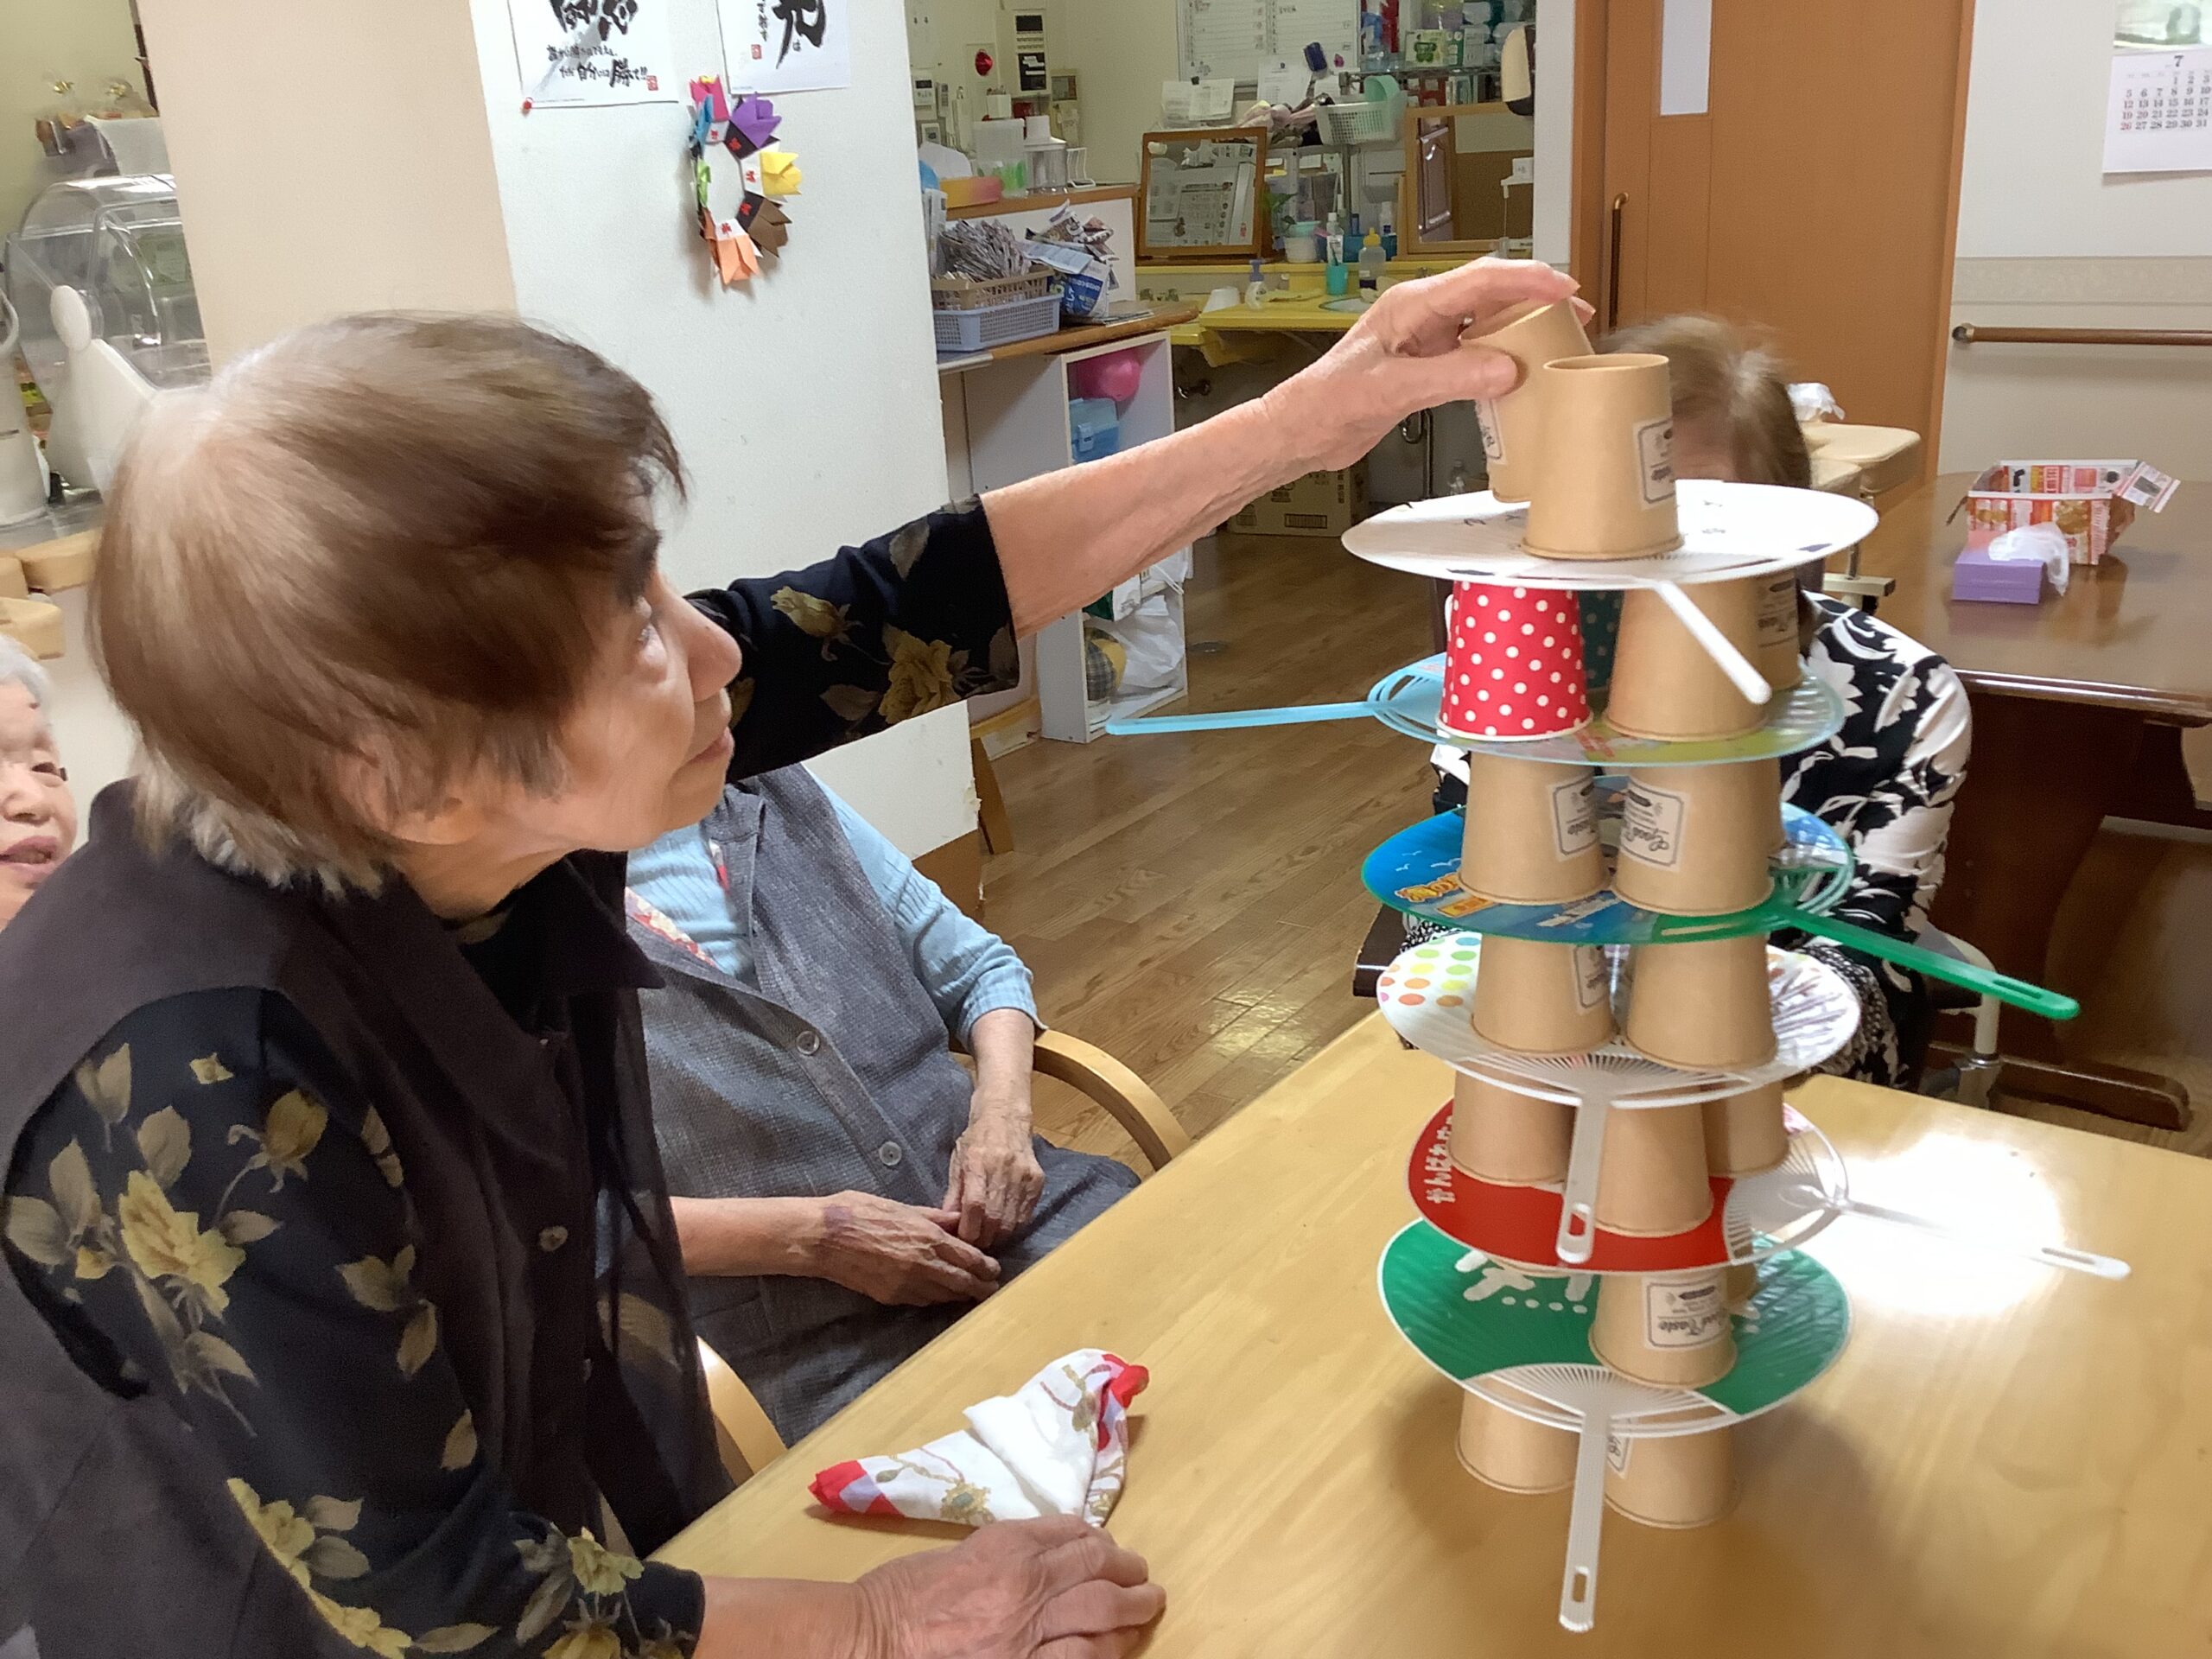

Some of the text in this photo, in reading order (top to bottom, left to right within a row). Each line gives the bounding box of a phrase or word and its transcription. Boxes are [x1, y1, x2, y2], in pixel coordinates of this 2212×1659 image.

[2174, 54, 2184, 67] 7
[2187, 75, 2195, 84] 2
[2126, 89, 2133, 98] 5
[2140, 88, 2148, 98] 6
[2157, 87, 2164, 97] 7
[2186, 86, 2194, 95] 9
[2201, 86, 2211, 94] 10
[2124, 100, 2133, 109] 12
[2139, 99, 2149, 108] 13
[2168, 98, 2179, 107] 15
[2183, 97, 2194, 106] 16
[2200, 97, 2209, 105] 17
[2136, 111, 2149, 119] 20
[2152, 110, 2163, 118] 21
[2166, 109, 2178, 118] 22
[2197, 108, 2209, 117] 24
[2135, 121, 2148, 130] 27
[2165, 120, 2178, 129] 29
[2180, 119, 2193, 128] 30
[2196, 118, 2208, 127] 31
